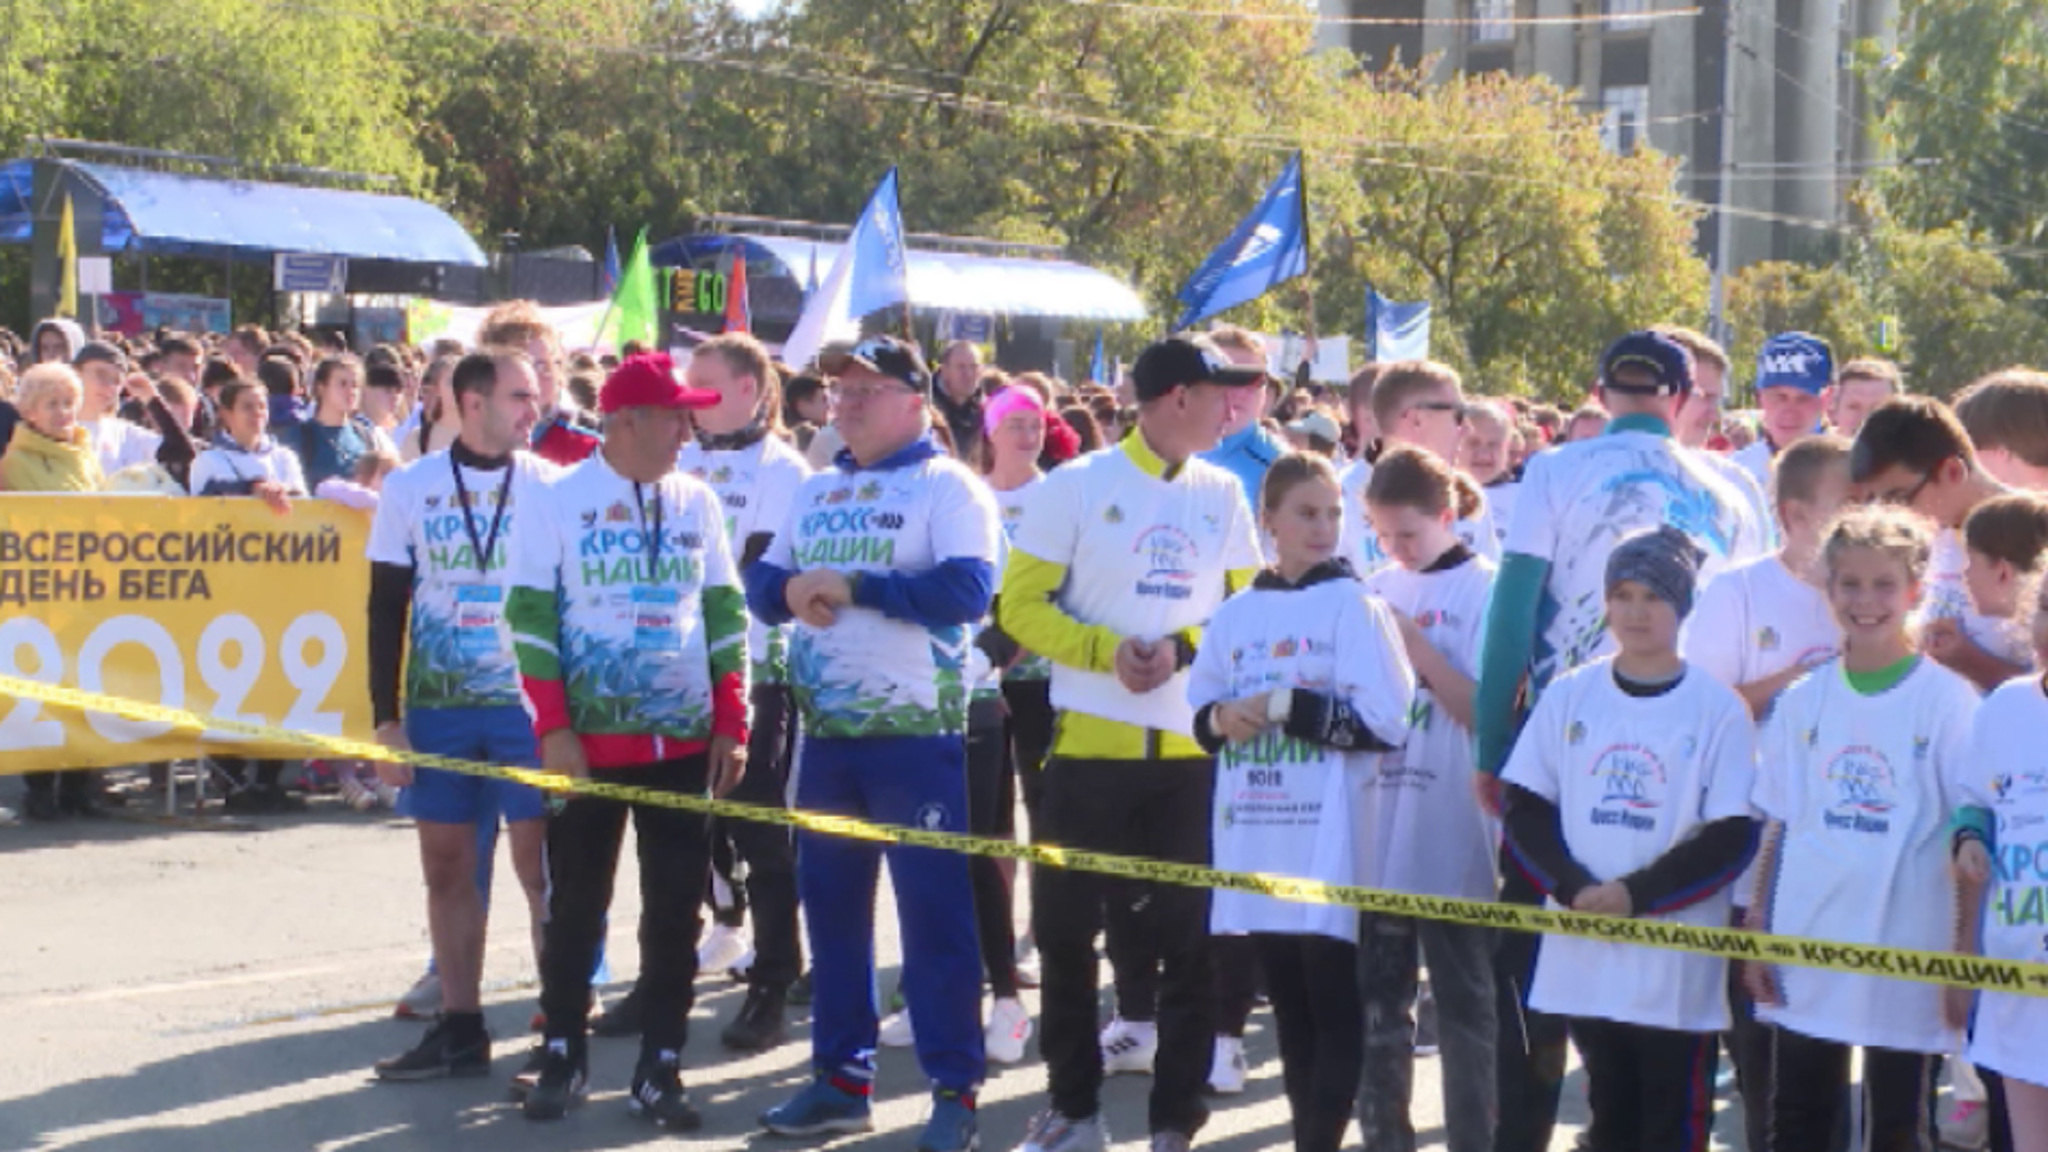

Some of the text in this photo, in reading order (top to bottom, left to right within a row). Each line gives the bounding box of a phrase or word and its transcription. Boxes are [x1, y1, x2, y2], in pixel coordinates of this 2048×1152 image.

[0, 524, 341, 563] ВСЕРОССИЙСКИЙ
[0, 569, 211, 607] ДЕНЬ БЕГА
[0, 610, 348, 750] 2022
[1557, 914, 1644, 940] КРОСС
[1645, 925, 1760, 956] НАЦИИ
[1799, 942, 1896, 972] КРОСС
[1897, 954, 2025, 989] НАЦИИ
